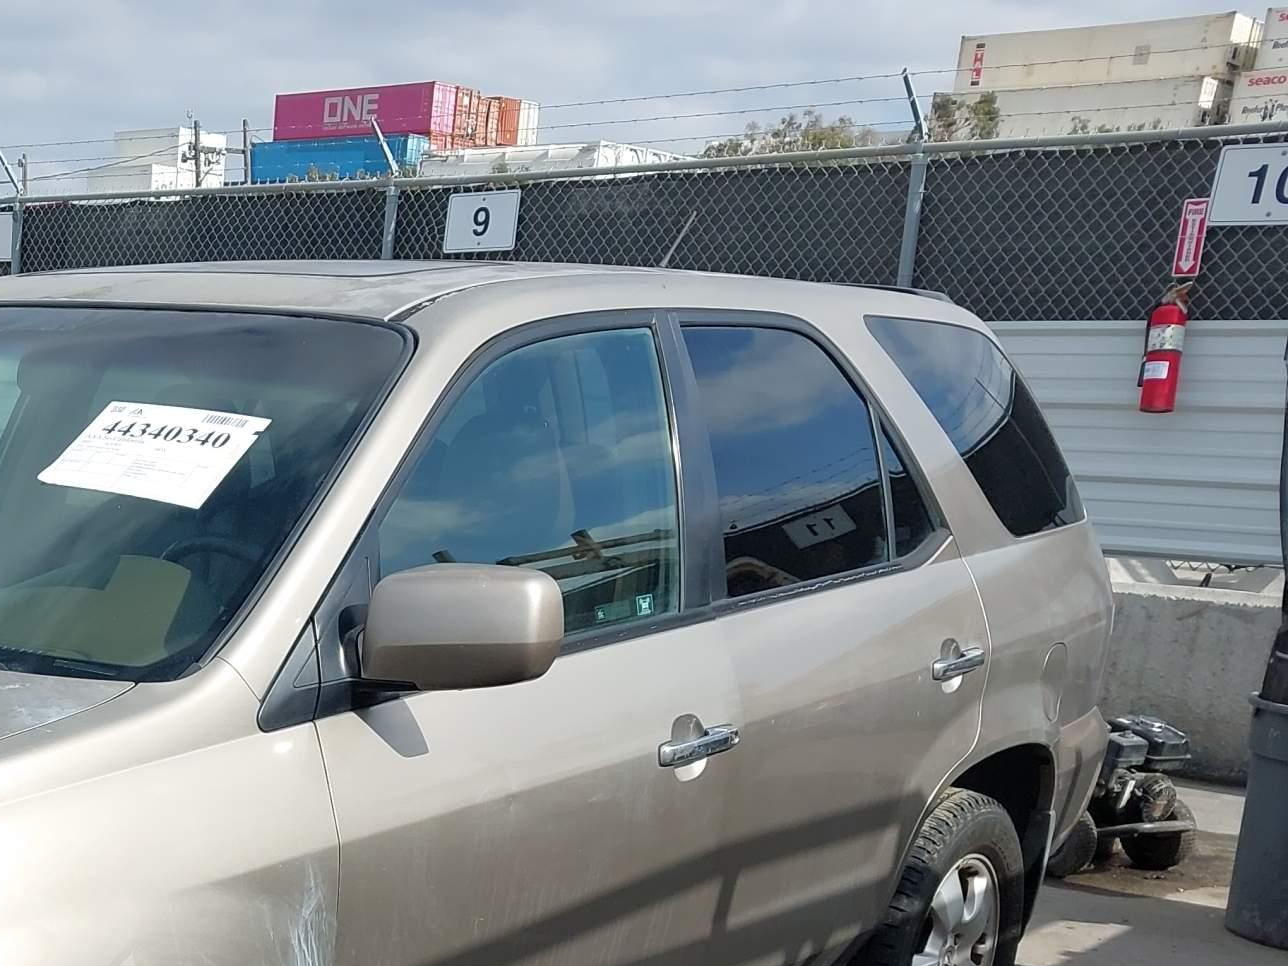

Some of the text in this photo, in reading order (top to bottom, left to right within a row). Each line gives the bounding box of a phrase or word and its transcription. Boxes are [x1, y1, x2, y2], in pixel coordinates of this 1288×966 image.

[1247, 75, 1287, 87] seaco
[323, 93, 380, 123] ONE
[472, 206, 491, 237] 9
[101, 420, 231, 449] 44340340
